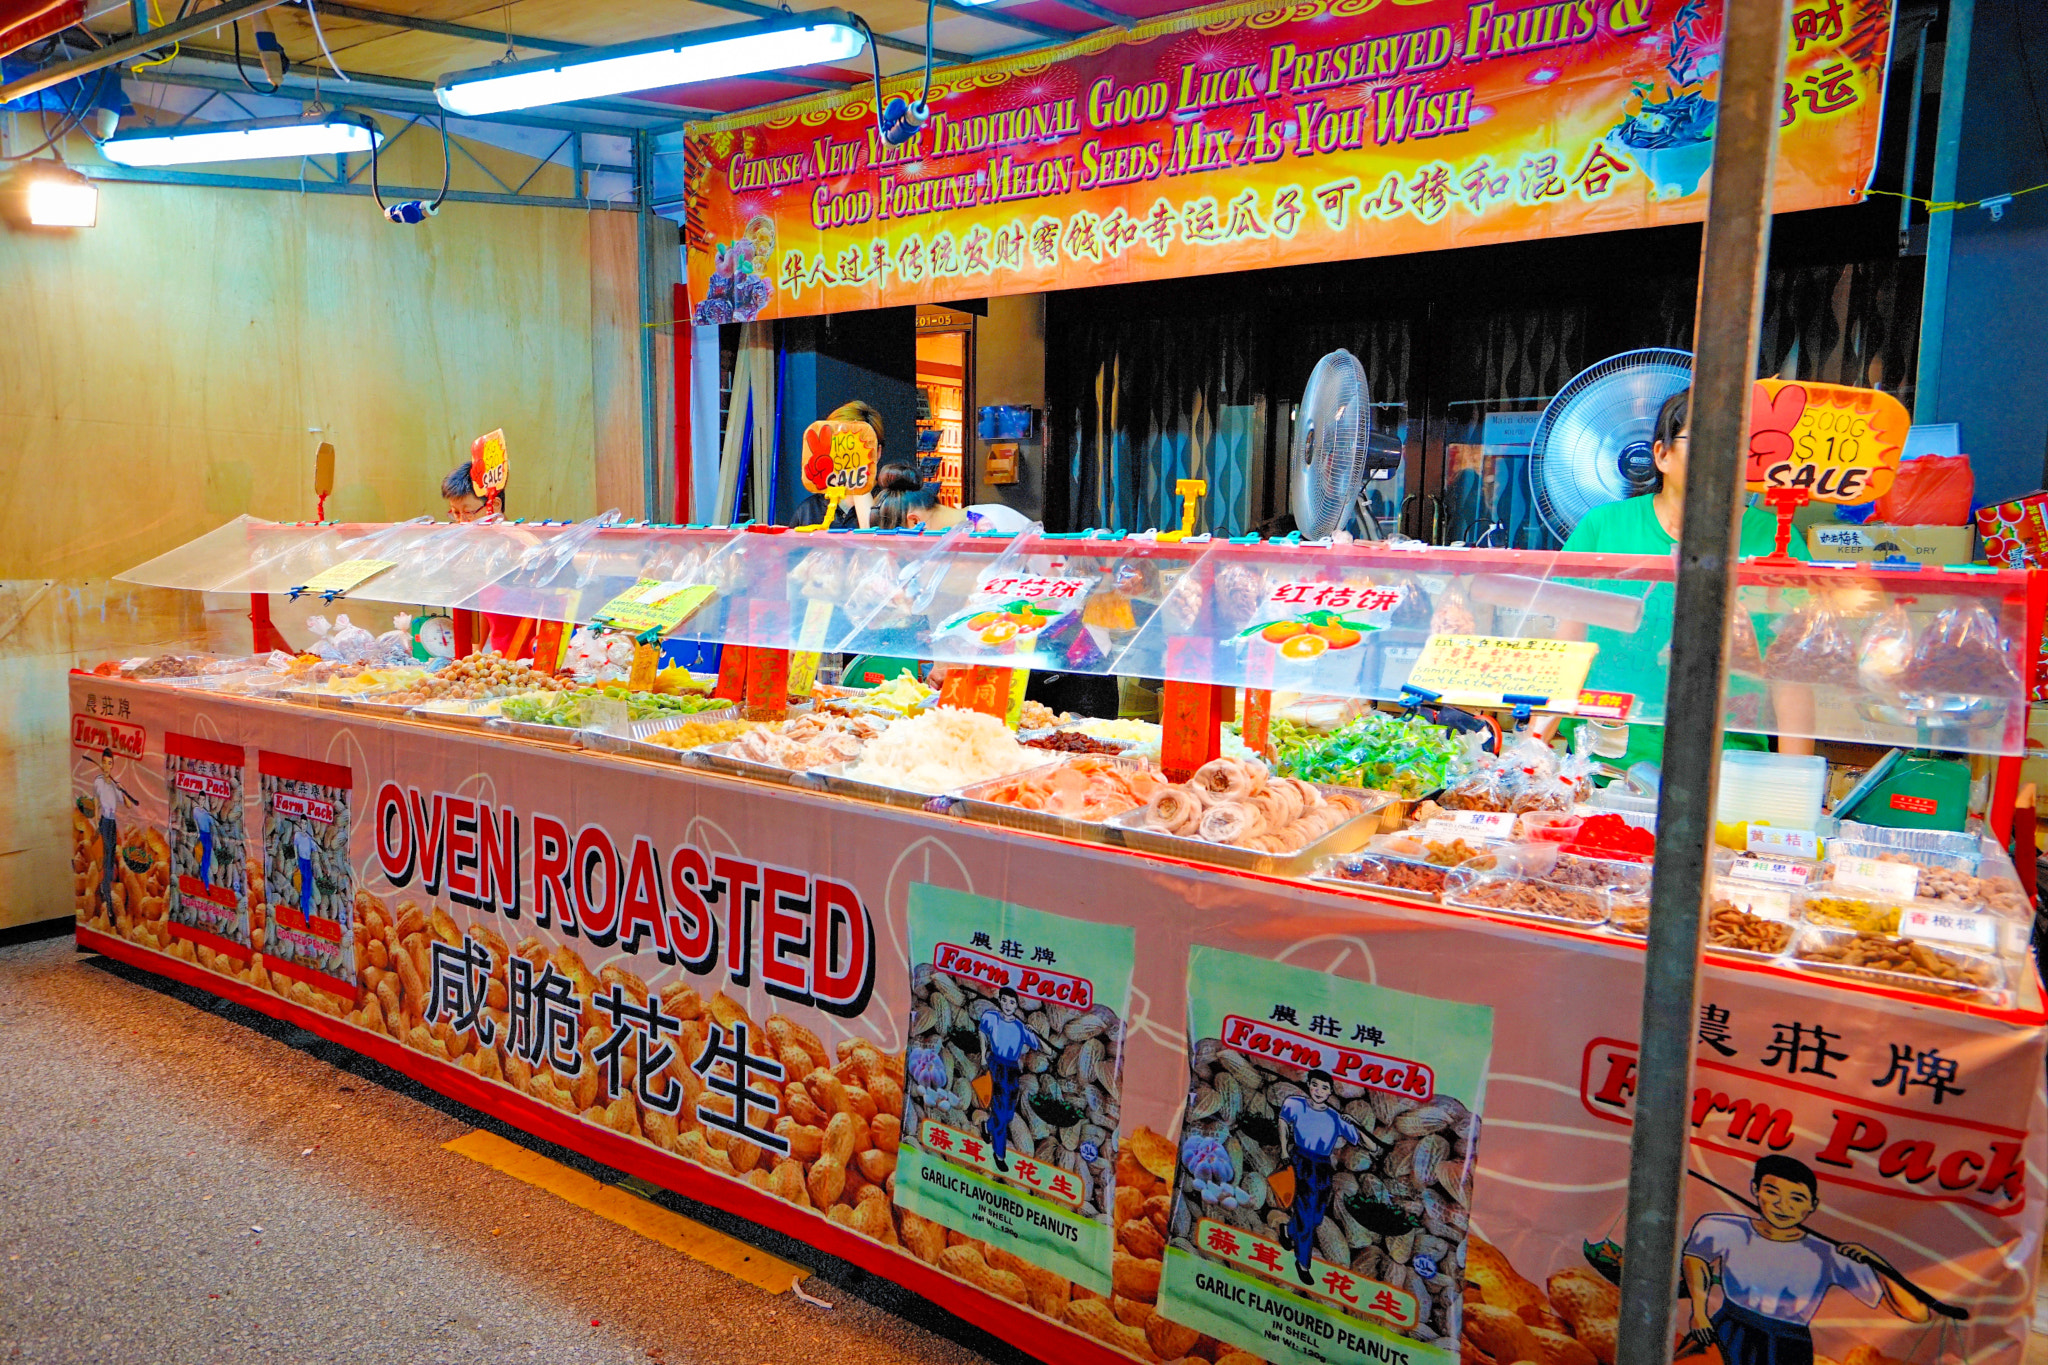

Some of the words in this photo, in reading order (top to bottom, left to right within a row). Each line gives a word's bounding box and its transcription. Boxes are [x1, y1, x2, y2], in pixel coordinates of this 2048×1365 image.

[808, 134, 860, 179] NEW
[930, 97, 1080, 158] TRADITIONAL
[1088, 75, 1170, 131] GOOD
[1174, 62, 1258, 115] LUCK
[1265, 25, 1455, 98] PRESERVED
[1461, 0, 1601, 61] FRUITS
[811, 183, 873, 232] GOOD
[877, 165, 978, 220] FORTUNE
[981, 153, 1076, 206] MELON
[1079, 138, 1164, 192] SEEDS
[1166, 119, 1234, 177] MIX
[1234, 110, 1287, 167] AS
[1293, 98, 1367, 158] YOU
[1373, 83, 1475, 147] WISH
[483, 465, 502, 488] SALE
[1766, 464, 1868, 498] SALE
[1837, 546, 1864, 554] KEEP
[1916, 546, 1937, 555] DRY
[275, 794, 304, 814] Farm
[306, 801, 333, 820] Pack
[374, 781, 519, 920] OVEN
[532, 813, 876, 1019] ROASTED
[938, 946, 1010, 986] Farm
[1016, 969, 1088, 1007] Pack
[969, 931, 1057, 966] 農莊牌
[423, 935, 792, 1158] 咸脆花生
[1227, 1019, 1322, 1069] Farm
[1332, 1050, 1428, 1097] Pack
[1268, 1004, 1386, 1048] 農莊牌
[1593, 1052, 1795, 1152] Frm
[1814, 1108, 2027, 1202] Pack
[920, 1166, 959, 1194] GARLIC
[960, 1181, 1025, 1219] FLAVOURED
[1026, 1209, 1079, 1243] PEANUTS
[1195, 1272, 1247, 1307] GARLIC
[1248, 1291, 1335, 1342] FLAVOURED
[1337, 1328, 1410, 1365] PEANUTS
[1271, 1320, 1284, 1332] IN
[1285, 1324, 1321, 1349] SHELL
